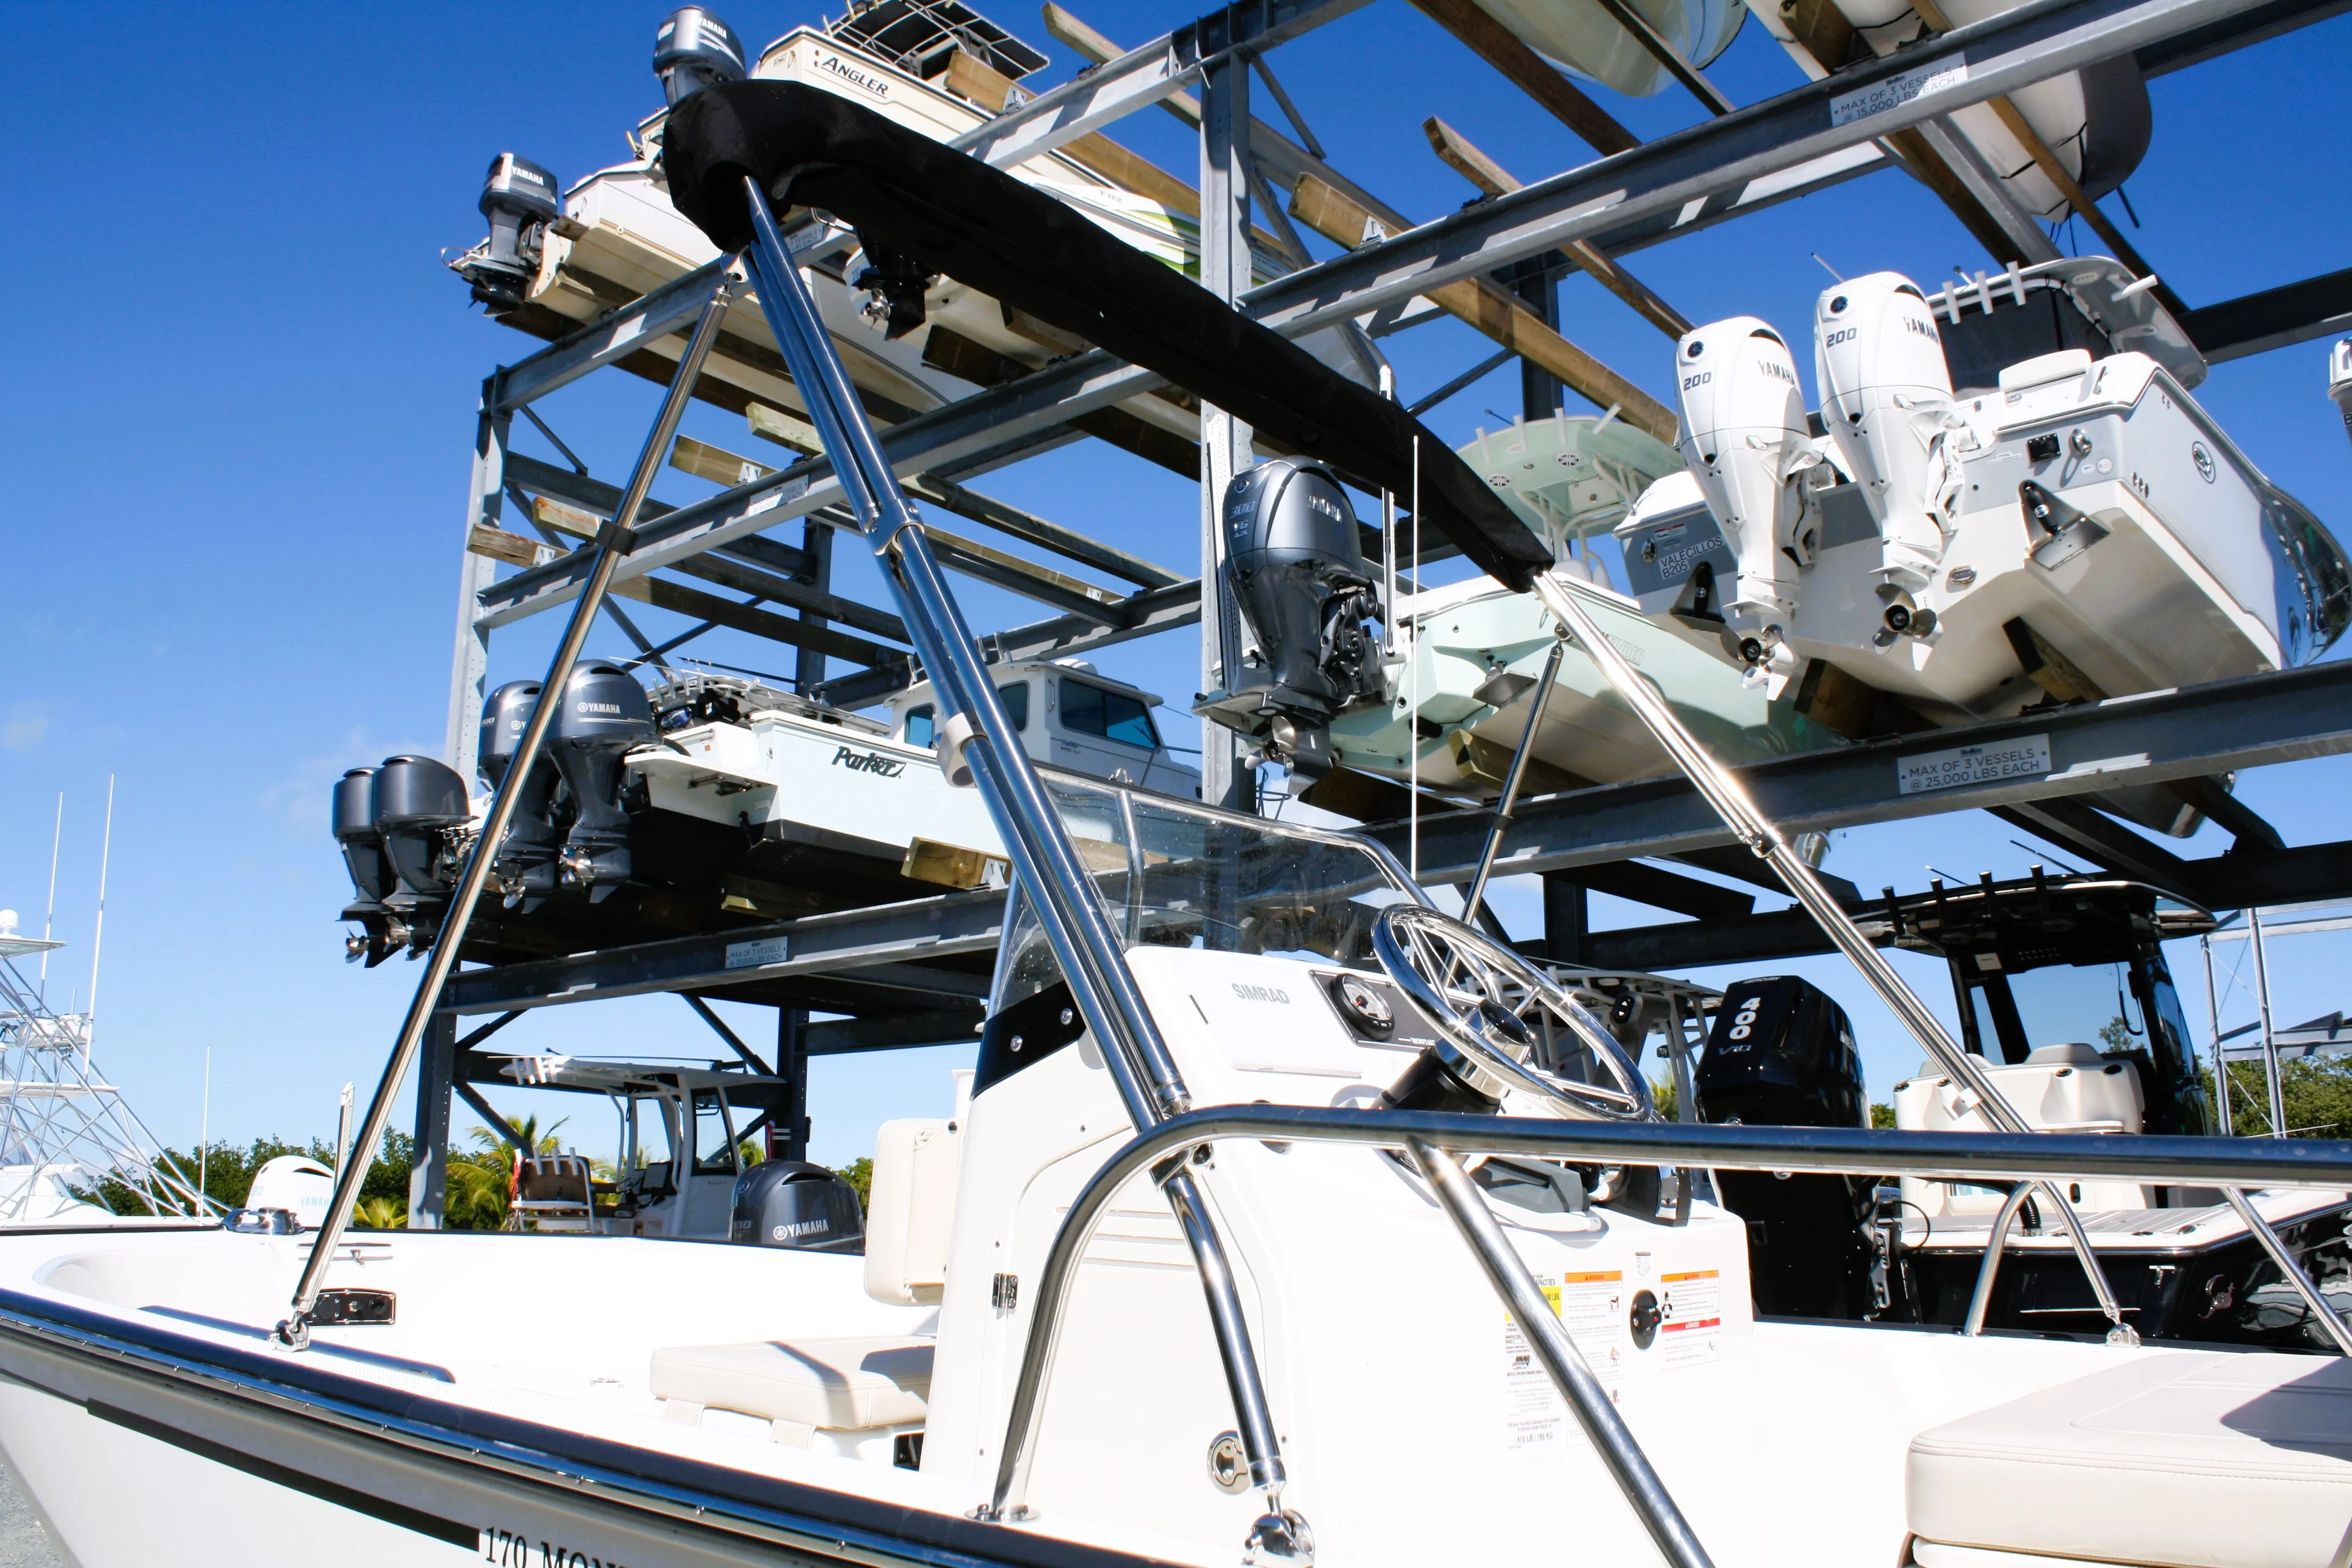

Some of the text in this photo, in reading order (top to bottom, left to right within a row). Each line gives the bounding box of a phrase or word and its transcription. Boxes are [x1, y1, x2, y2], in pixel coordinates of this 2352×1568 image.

[697, 16, 728, 40] YAMAHA
[820, 56, 889, 96] ANGLER
[1840, 97, 1866, 114] MAX
[1870, 90, 1886, 102] OF
[1889, 87, 1896, 96] 3
[1900, 67, 1952, 91] VESSELS
[1843, 113, 1854, 122] @
[1857, 98, 1893, 117] 15,000
[1896, 90, 1919, 104] LBS
[1922, 76, 1956, 94] EACH
[511, 165, 544, 186] YAMAHA
[1826, 327, 1857, 349] 200
[1684, 371, 1712, 392] 200
[1757, 360, 1795, 388] YAMAHA
[1660, 536, 1723, 567] VALECILLOS
[1663, 561, 1688, 578] B205
[587, 702, 621, 714] YAMAHA
[831, 745, 900, 777] Parker
[1909, 764, 1938, 778] MAX
[1942, 760, 1960, 773] OF
[1964, 759, 1972, 769] 3
[1975, 748, 2035, 766] VESSELS
[1910, 760, 2040, 791] @ 25,000 LBS EACH
[757, 945, 781, 955] VESSELS
[766, 953, 782, 961] EACH
[1231, 982, 1290, 1004] SIMRAD
[1729, 997, 1762, 1040] 400
[787, 1219, 829, 1238] YAMAHA
[486, 1526, 528, 1568] 170
